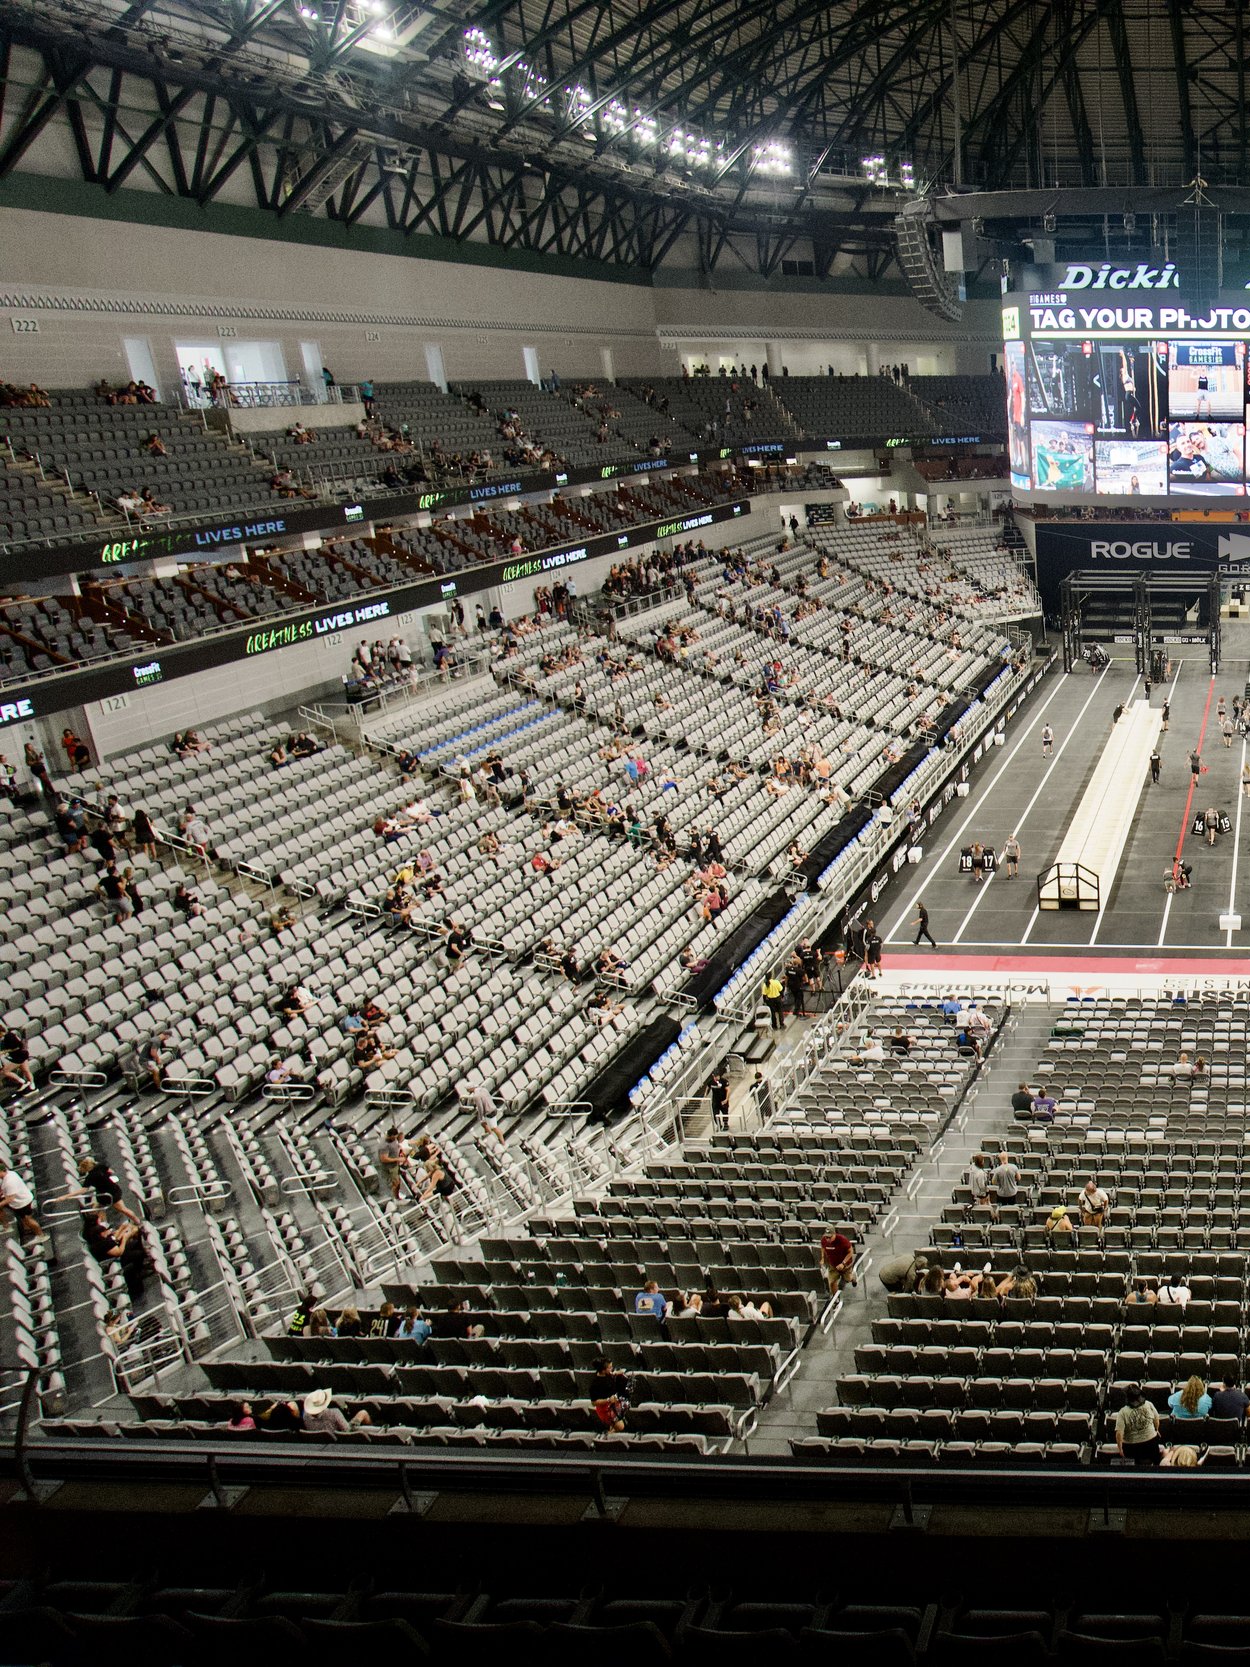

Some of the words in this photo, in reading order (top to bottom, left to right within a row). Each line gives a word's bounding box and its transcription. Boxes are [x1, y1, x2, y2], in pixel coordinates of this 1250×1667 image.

[1058, 264, 1179, 289] Dicki
[1030, 308, 1075, 329] TAG
[1079, 308, 1153, 329] YOUR
[15, 321, 38, 332] 222
[220, 328, 236, 337] 223
[757, 443, 783, 452] HERE
[634, 462, 651, 472] LIVES
[651, 459, 668, 469] HERE
[471, 486, 497, 499] LIVES
[498, 482, 522, 495] HERE
[195, 527, 242, 545] LIVES
[245, 521, 286, 537] HERE
[1091, 541, 1190, 559] ROGUE
[542, 554, 565, 569] LIVES
[566, 548, 587, 564] HERE
[246, 620, 313, 654] GREATNESS
[316, 612, 354, 633] LIVES
[355, 602, 390, 622] HERE
[327, 635, 342, 646] 122
[106, 696, 127, 711] 121
[0, 699, 34, 723] RE
[1195, 820, 1203, 831] 16
[1221, 817, 1230, 829] 15
[962, 856, 972, 867] 18
[984, 855, 994, 867] 17
[899, 983, 1048, 995] Momentous
